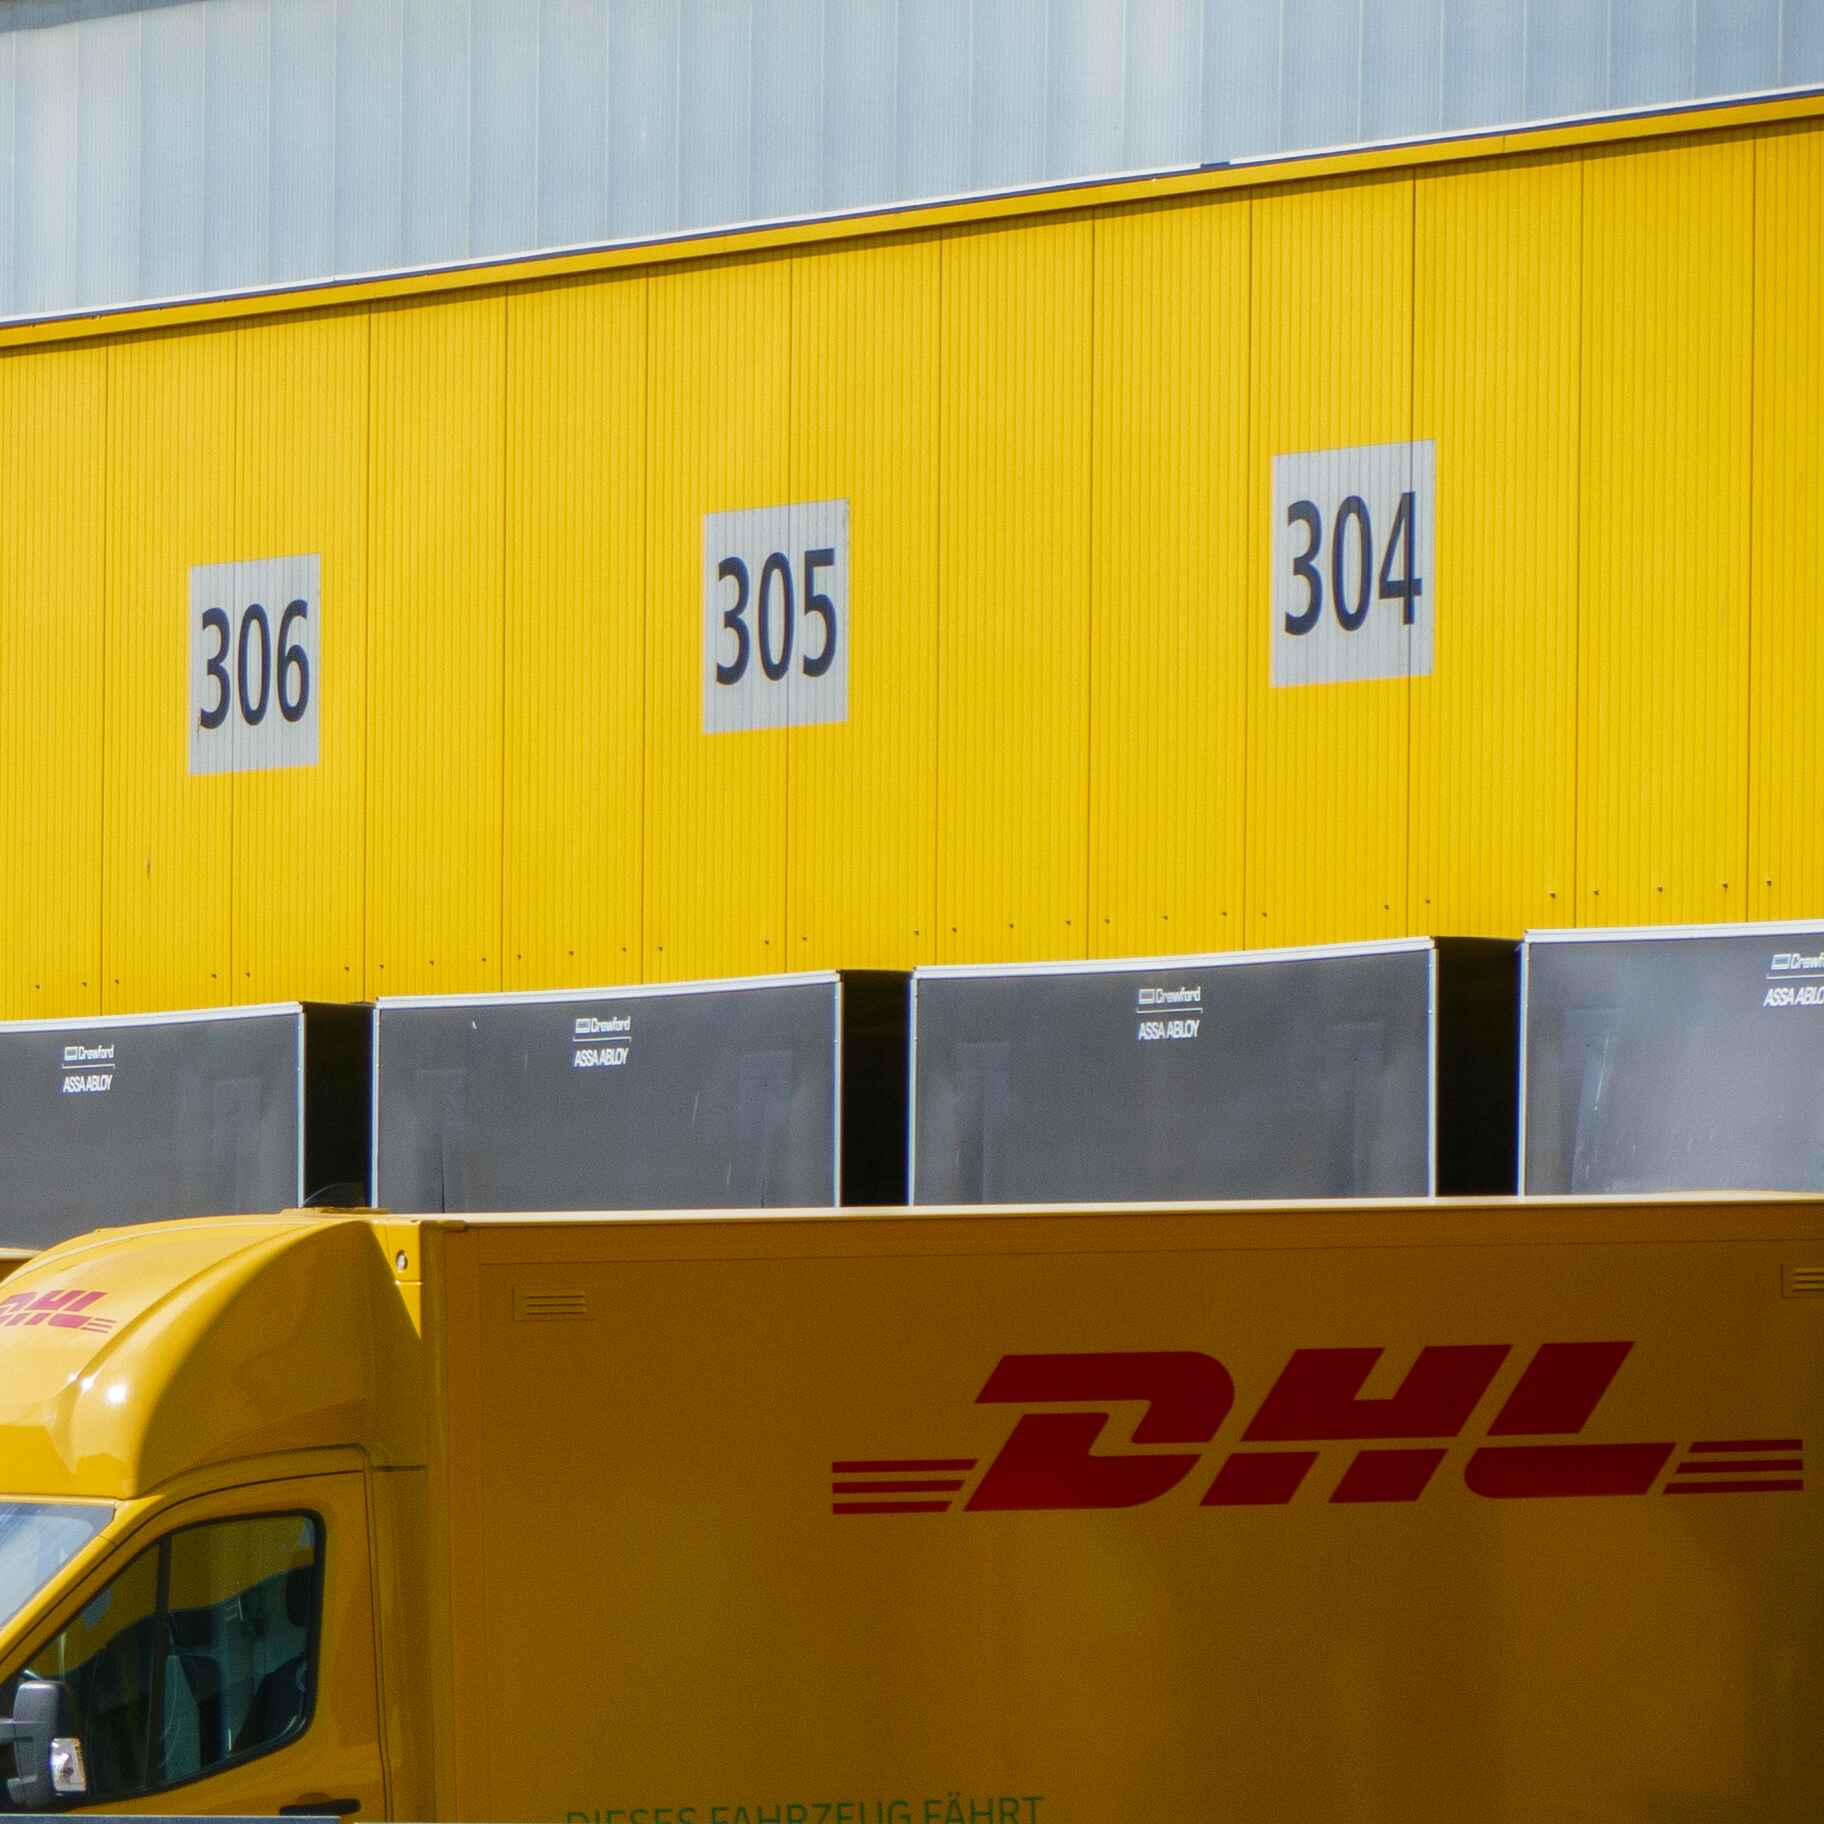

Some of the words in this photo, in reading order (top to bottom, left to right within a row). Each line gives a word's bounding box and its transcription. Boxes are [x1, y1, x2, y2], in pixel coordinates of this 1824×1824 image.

[715, 547, 838, 686] 305
[1285, 490, 1423, 636] 304
[199, 598, 310, 730] 306
[63, 1075, 85, 1093] ASSA
[574, 1048, 598, 1067] ASSA
[599, 1047, 629, 1065] ABLOY
[1138, 1021, 1165, 1040] ASSA
[1166, 1019, 1201, 1038] ABLOY
[962, 1340, 1678, 1513] DHL
